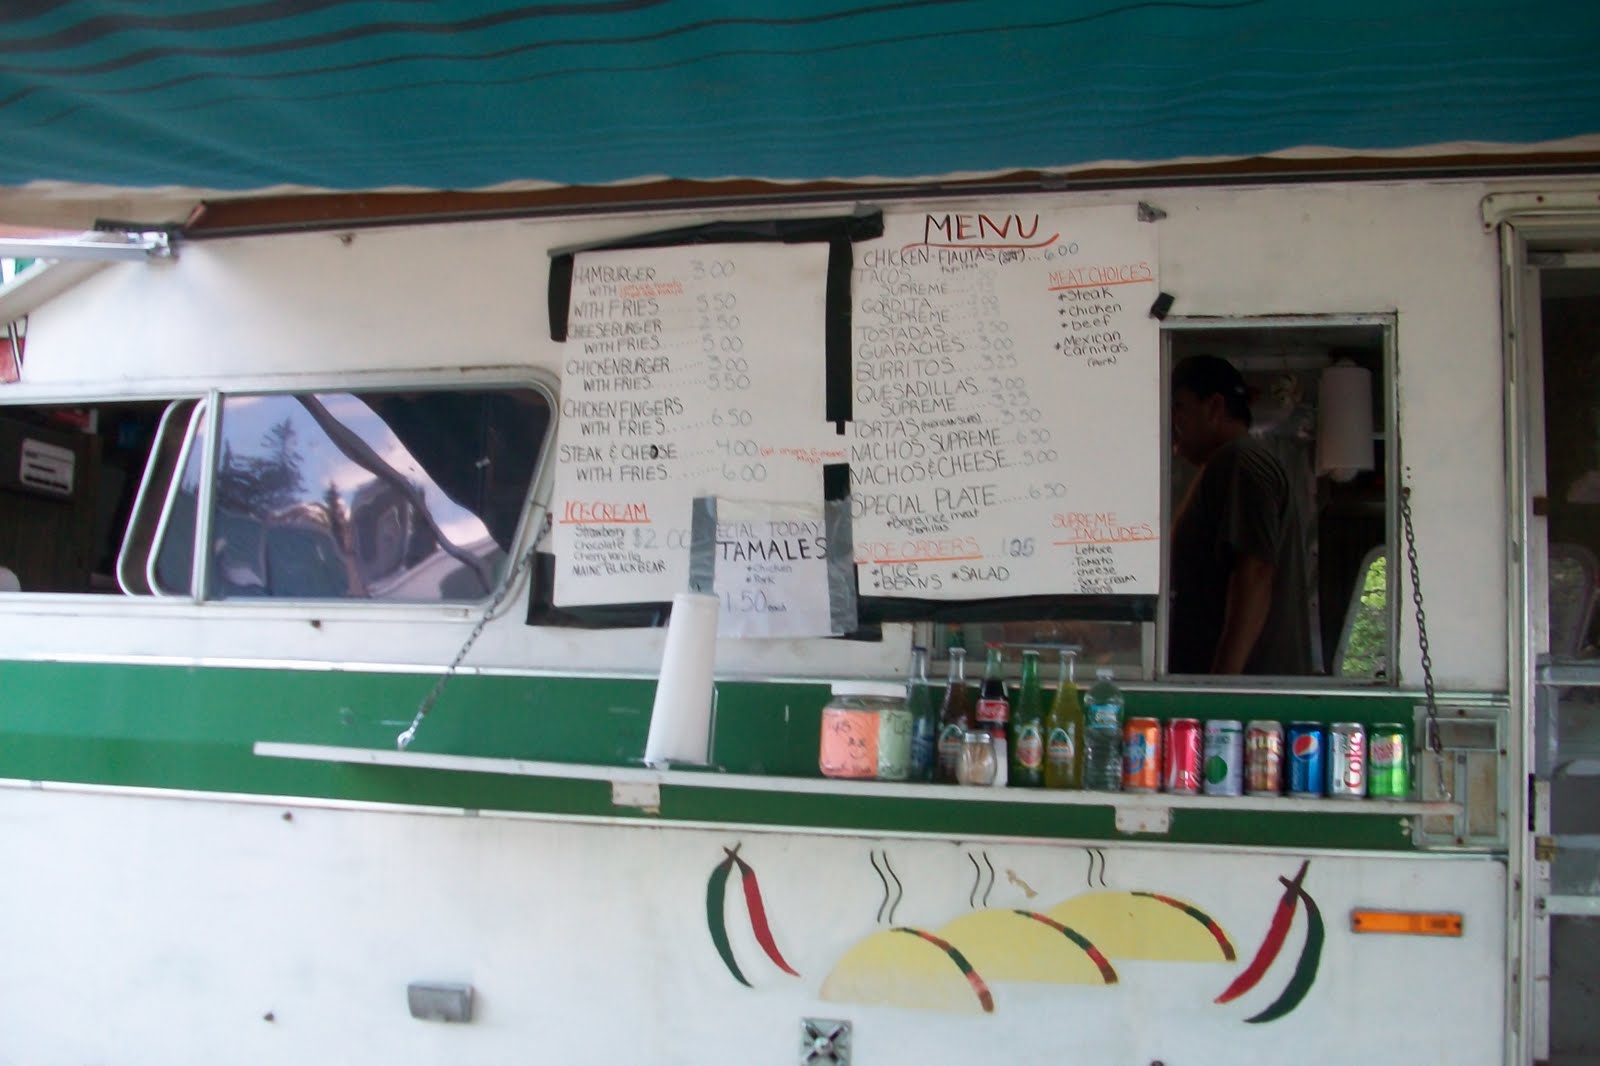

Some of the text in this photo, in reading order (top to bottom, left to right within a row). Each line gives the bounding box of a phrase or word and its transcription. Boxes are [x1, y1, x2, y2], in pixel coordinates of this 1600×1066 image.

[921, 213, 1040, 244] MENU
[863, 247, 930, 270] CHICKEN
[853, 268, 912, 285] TACOS
[1048, 261, 1152, 287] MEAT CHOICES
[880, 282, 951, 296] SUPREME
[609, 298, 660, 318] FRIES
[880, 310, 950, 328] SUPREME
[1071, 314, 1111, 331] beef
[858, 323, 946, 343] TOSTADAS
[1063, 330, 1121, 346] Mexican
[584, 341, 614, 354] WITH
[617, 335, 661, 353] FRIES
[859, 336, 965, 361] GUARACHES
[857, 356, 955, 382] BURRITOS
[583, 378, 610, 392] WITH
[614, 375, 652, 392] FRIES
[856, 376, 979, 405] QUESADILLAS
[562, 396, 684, 419] CHICKEN FINGERS
[880, 397, 957, 417] SUPREME
[580, 421, 611, 436] WITH
[618, 417, 666, 436] FRIES
[850, 416, 920, 440] TORTAS
[560, 444, 603, 463] STEAK
[621, 443, 678, 461] CHESE
[851, 438, 926, 463] NACHOS
[929, 427, 1001, 456] SUPREME
[577, 466, 612, 482] WITH
[620, 463, 669, 482] FRIES
[850, 461, 926, 486] NACHOS
[937, 450, 1008, 479] CHEESE
[851, 492, 926, 520] SPECIAL
[935, 484, 999, 513] PLATE
[768, 520, 820, 537] TODAY
[1051, 512, 1117, 528] SUPREME
[1072, 522, 1154, 541] INCLUDES
[716, 537, 828, 562] TAMALES
[856, 542, 896, 560] SIDE
[900, 536, 981, 558] ORDERS
[882, 574, 943, 591] BEANS
[959, 565, 1010, 582] SALAD
[1344, 732, 1363, 788] Coke
